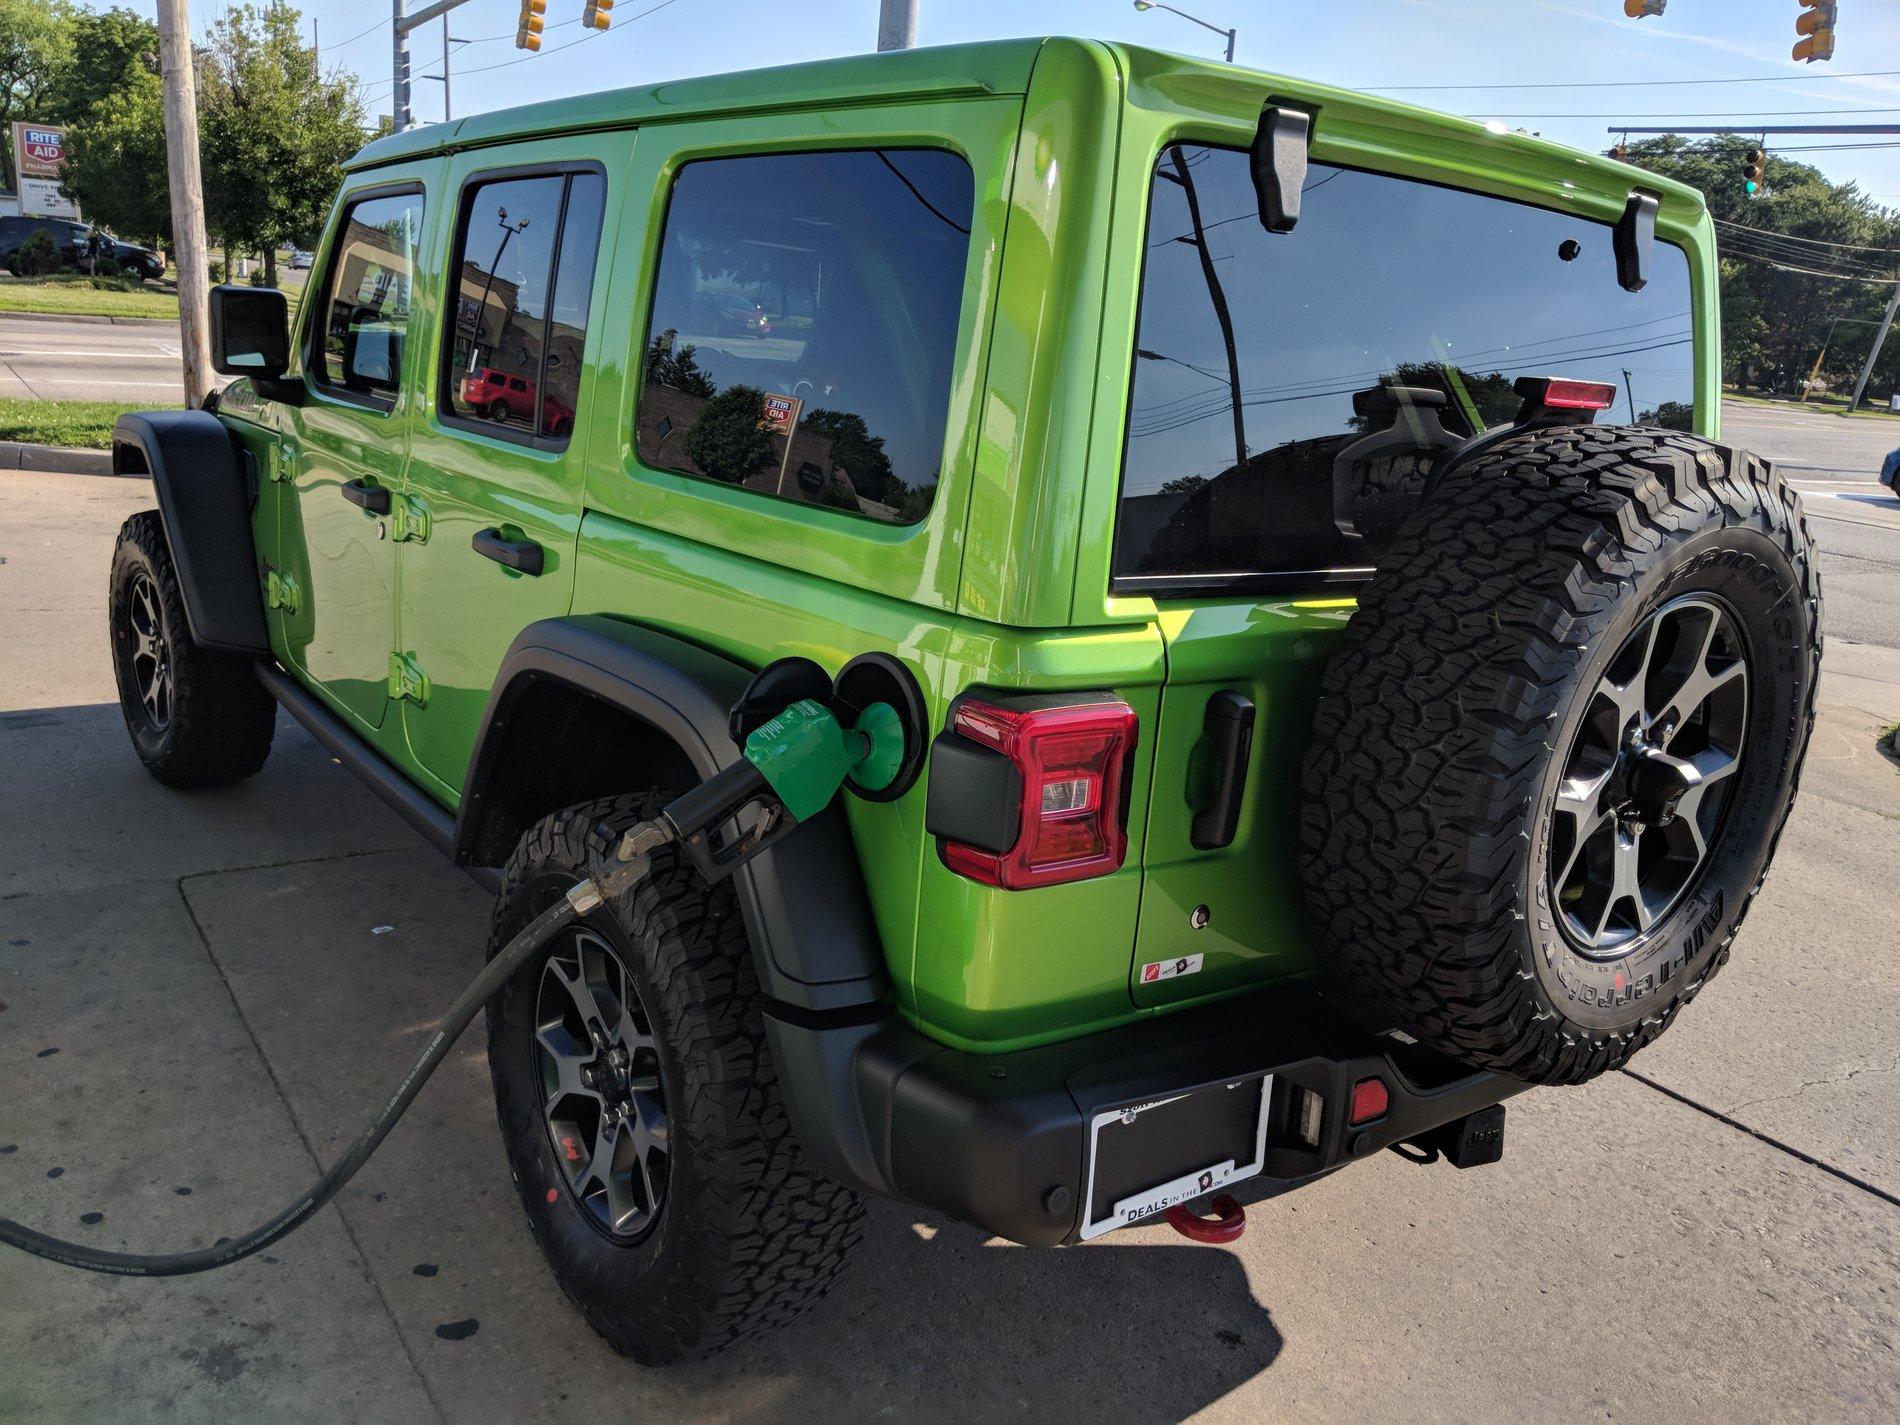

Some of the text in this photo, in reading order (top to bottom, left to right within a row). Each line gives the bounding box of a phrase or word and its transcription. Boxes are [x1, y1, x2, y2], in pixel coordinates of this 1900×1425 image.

[30, 131, 59, 143] RITE
[34, 146, 58, 158] AID
[26, 162, 58, 171] PHARMA
[1127, 1197, 1168, 1222] DEALS
[1169, 1194, 1180, 1204] IN
[1182, 1188, 1198, 1200] THE
